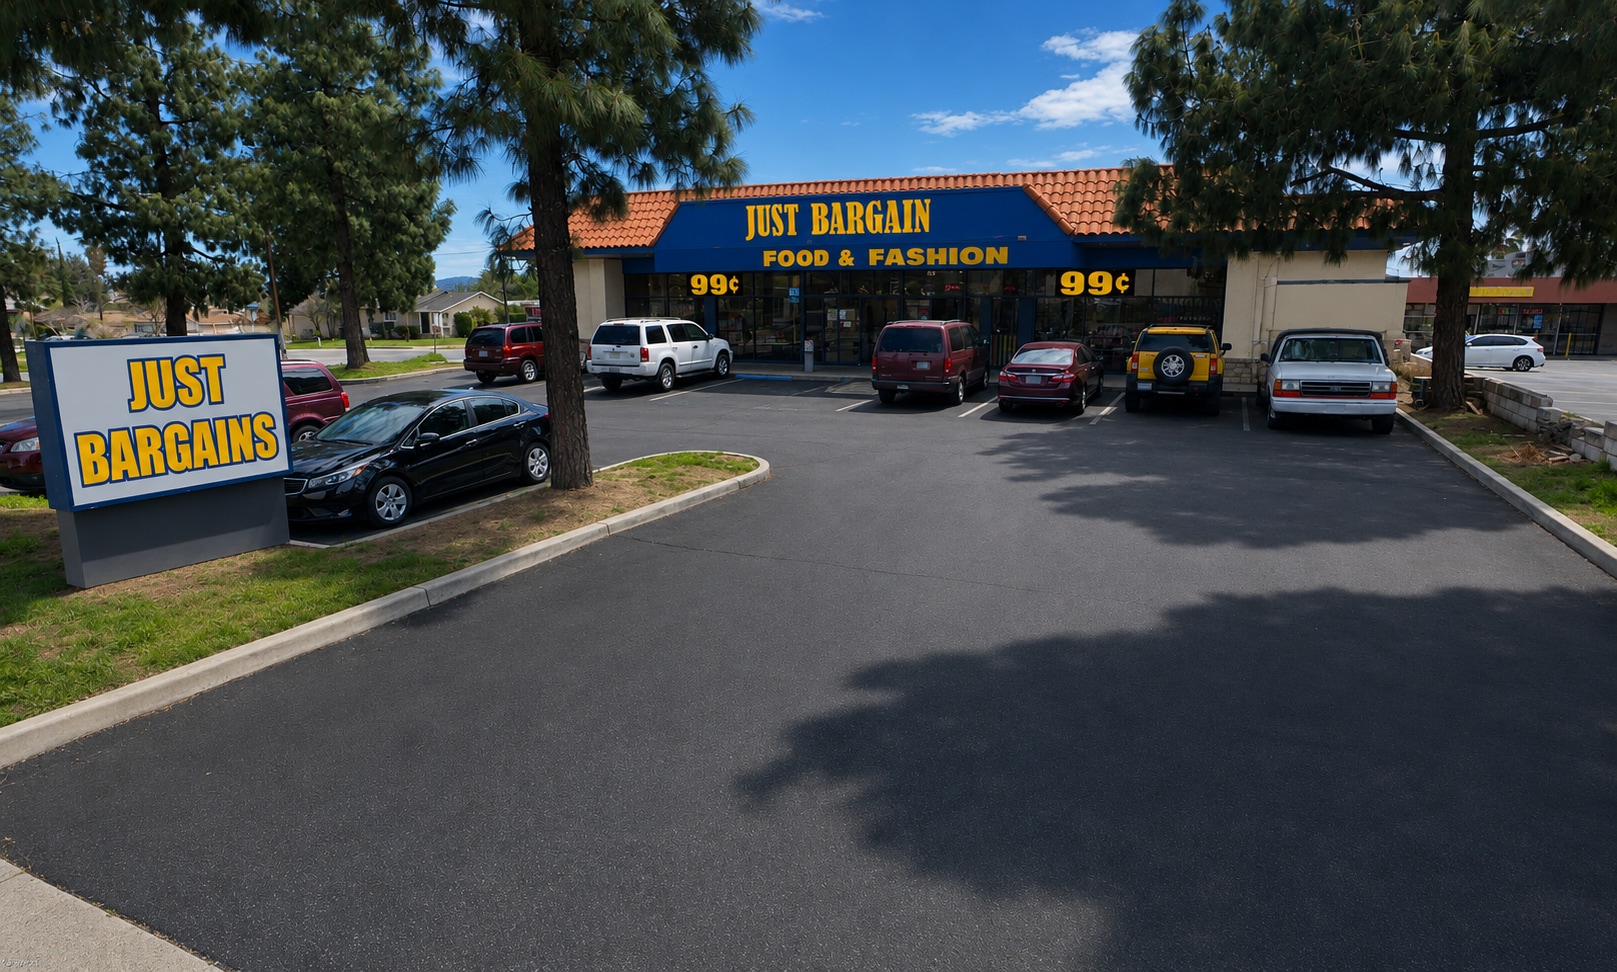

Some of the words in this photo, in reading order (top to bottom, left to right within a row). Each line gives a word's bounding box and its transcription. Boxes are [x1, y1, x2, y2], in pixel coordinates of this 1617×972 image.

[745, 203, 800, 241] JUST
[811, 199, 931, 235] BARGAIN
[762, 249, 829, 267] FOOD
[838, 249, 855, 267] &
[868, 246, 1008, 266] FASHION
[690, 273, 740, 296] 99¢
[1060, 270, 1131, 296] 99¢
[127, 354, 226, 411] JUST
[74, 412, 279, 488] BARGAINS
